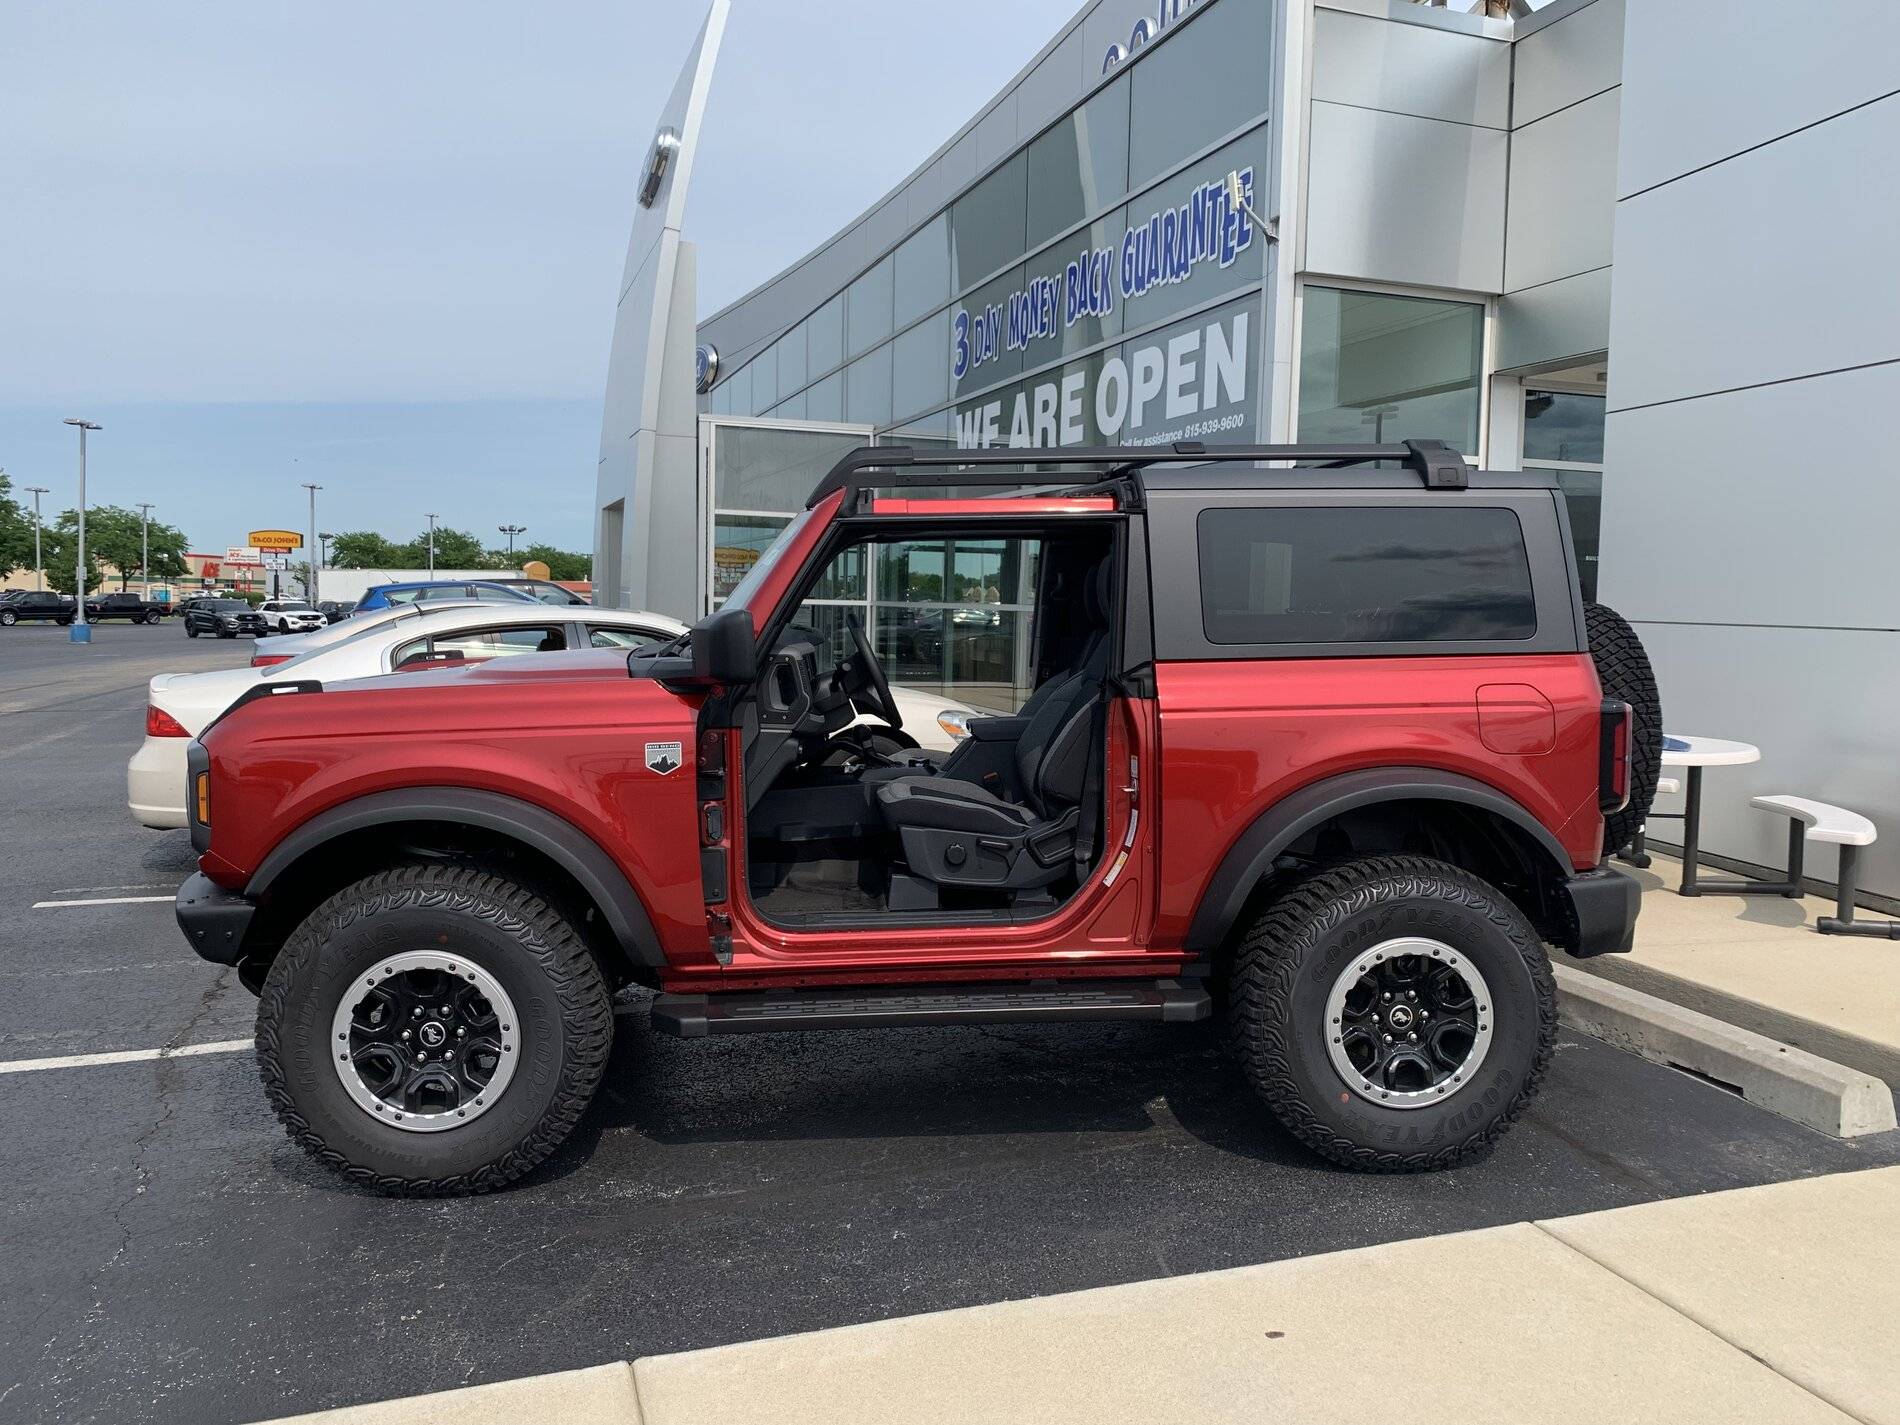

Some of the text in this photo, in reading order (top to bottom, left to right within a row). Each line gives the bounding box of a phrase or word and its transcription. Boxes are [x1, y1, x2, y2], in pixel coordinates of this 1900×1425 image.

[953, 166, 1253, 380] 3 DAY MONEY BACK GUARANTEE
[956, 312, 1248, 449] WE ARE OPEN
[1143, 429, 1183, 447] assistance
[1185, 413, 1245, 438] 815-939-9600
[201, 560, 220, 578] ACE
